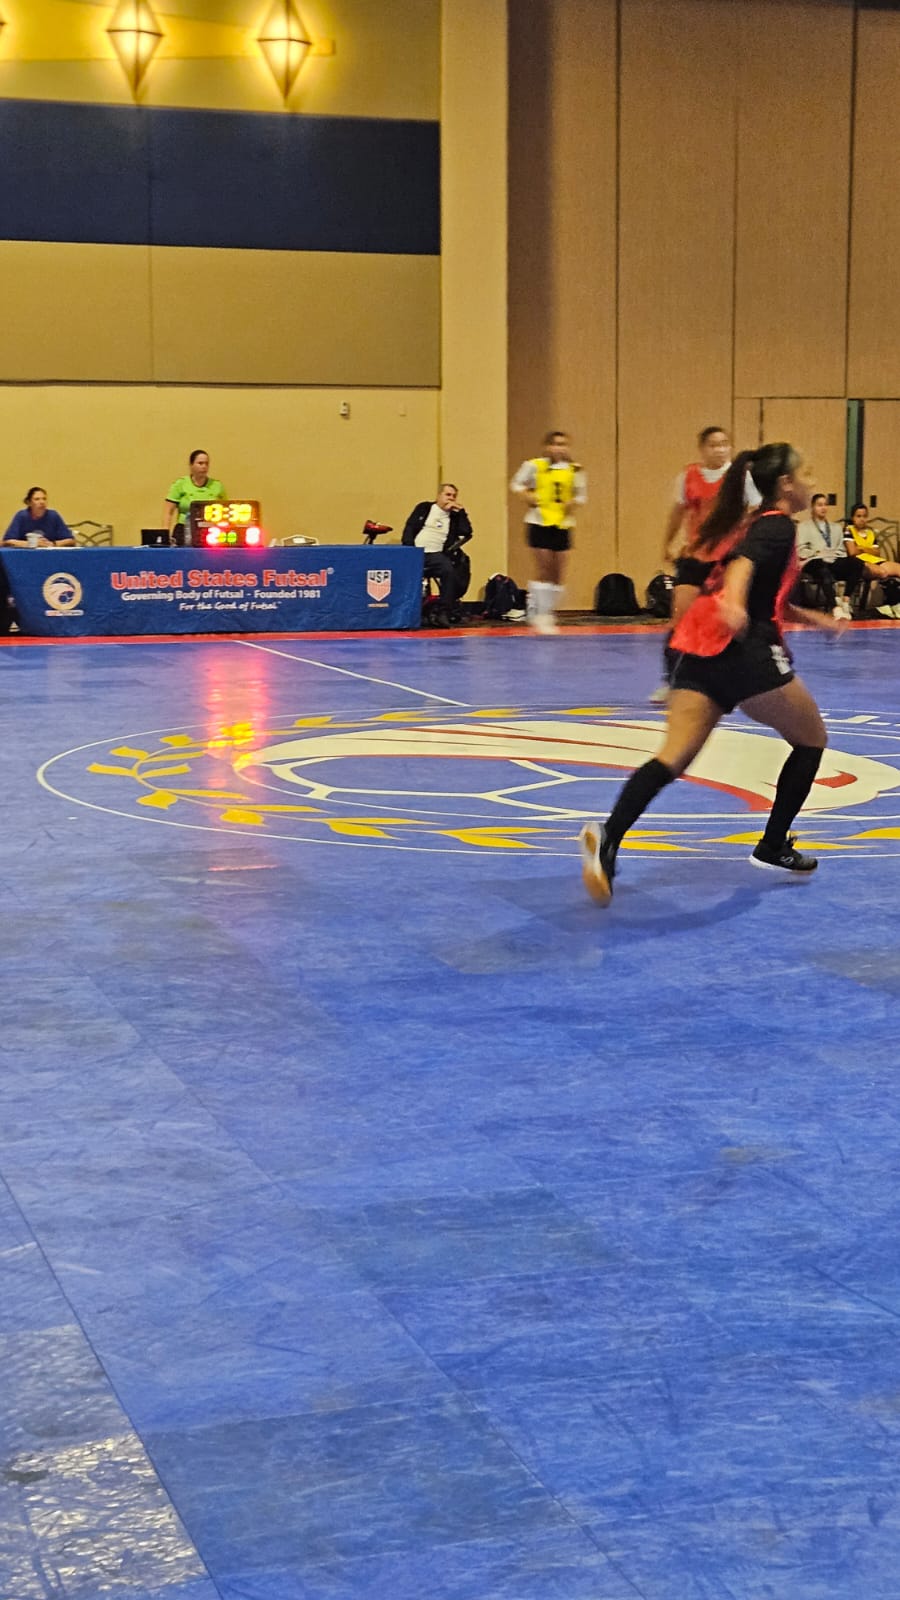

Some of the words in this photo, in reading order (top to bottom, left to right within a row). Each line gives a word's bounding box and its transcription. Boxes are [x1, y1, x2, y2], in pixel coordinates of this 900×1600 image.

[111, 569, 183, 590] United
[188, 569, 258, 587] States
[121, 591, 174, 602] Governing
[175, 590, 200, 600] Body
[202, 589, 213, 599] of
[214, 589, 244, 598] Futsal
[254, 589, 297, 598] Founded
[298, 589, 321, 598] 1981
[179, 602, 194, 611] For
[196, 602, 212, 610] the
[214, 601, 237, 610] Good
[238, 601, 249, 612] of
